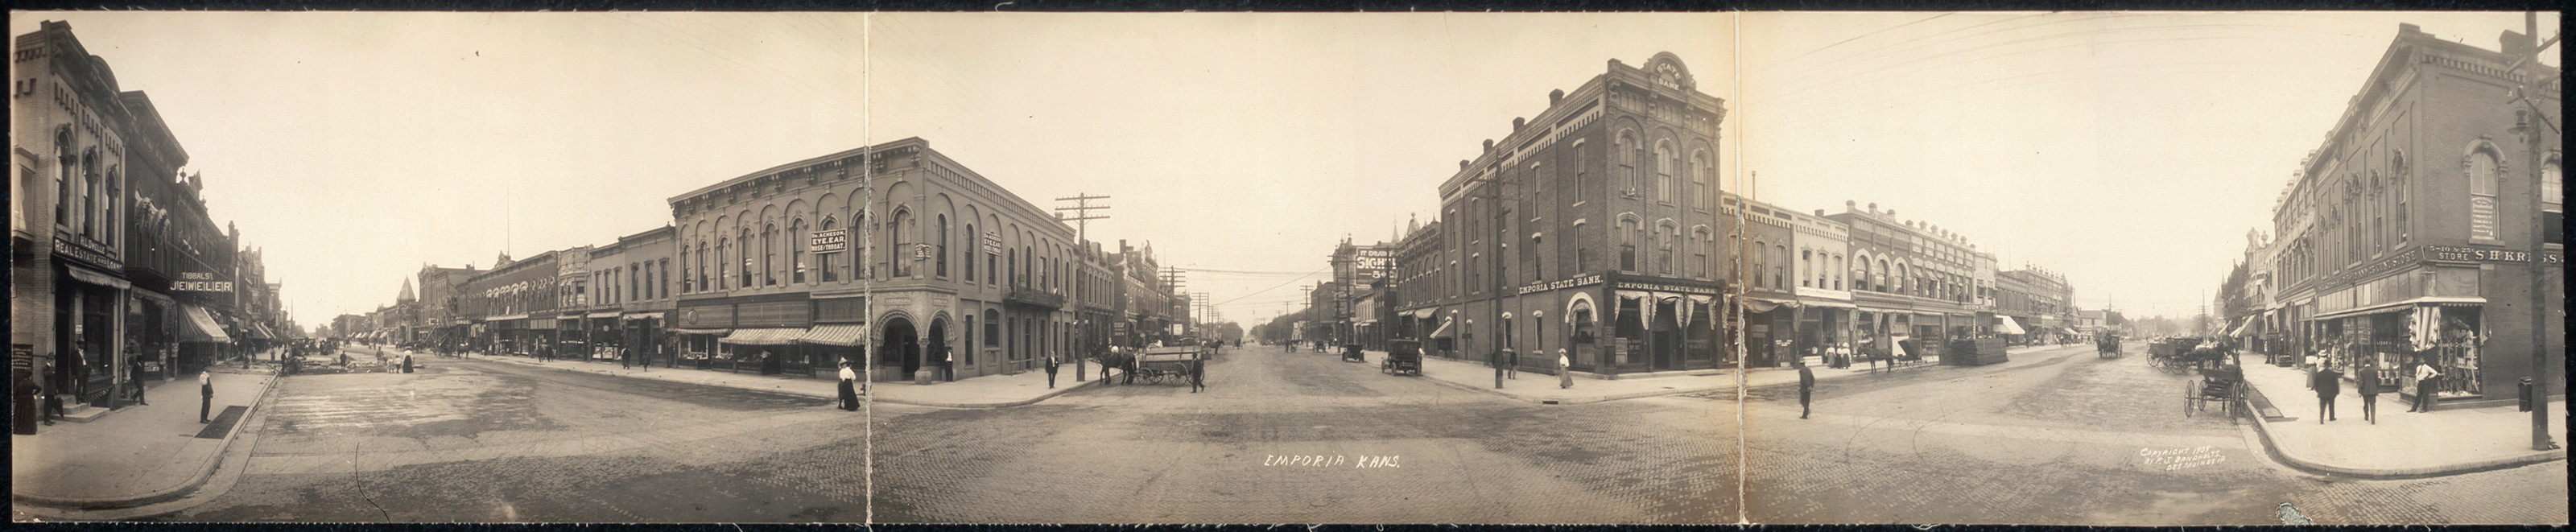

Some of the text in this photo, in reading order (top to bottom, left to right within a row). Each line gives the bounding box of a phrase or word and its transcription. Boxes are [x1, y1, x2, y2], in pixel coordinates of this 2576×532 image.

[1657, 63, 1681, 80] STATE
[1659, 78, 1679, 91] BANK
[55, 239, 73, 256] REAL
[75, 247, 97, 264] ESTATE
[2392, 250, 2416, 267] STORE
[2439, 252, 2469, 260] STORE
[170, 281, 231, 291] JEWELER
[1519, 275, 1603, 294] EMPORIA STATE BANK.
